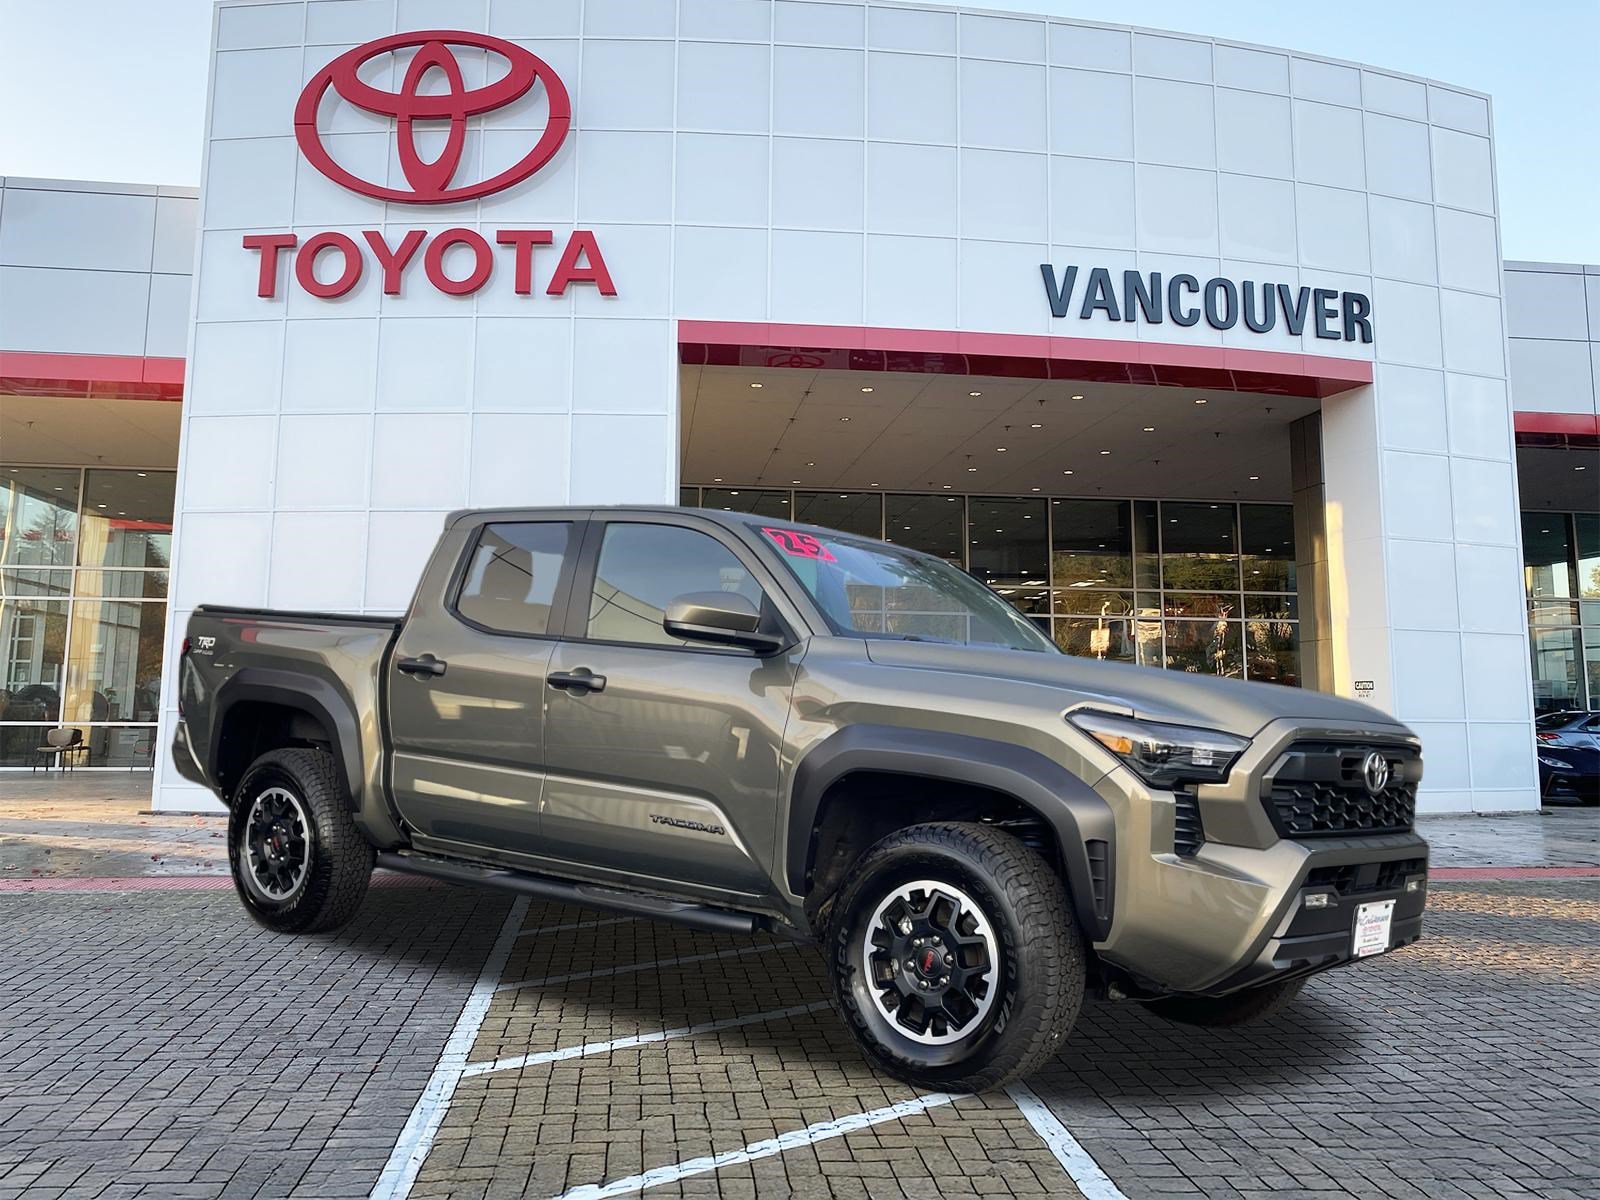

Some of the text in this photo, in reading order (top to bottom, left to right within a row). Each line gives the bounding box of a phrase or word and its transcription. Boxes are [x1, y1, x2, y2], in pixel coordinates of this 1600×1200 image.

[243, 228, 618, 298] TOYOTA
[1040, 264, 1373, 343] VANCOUVER
[198, 636, 215, 648] TRD
[649, 814, 725, 835] TACOMA
